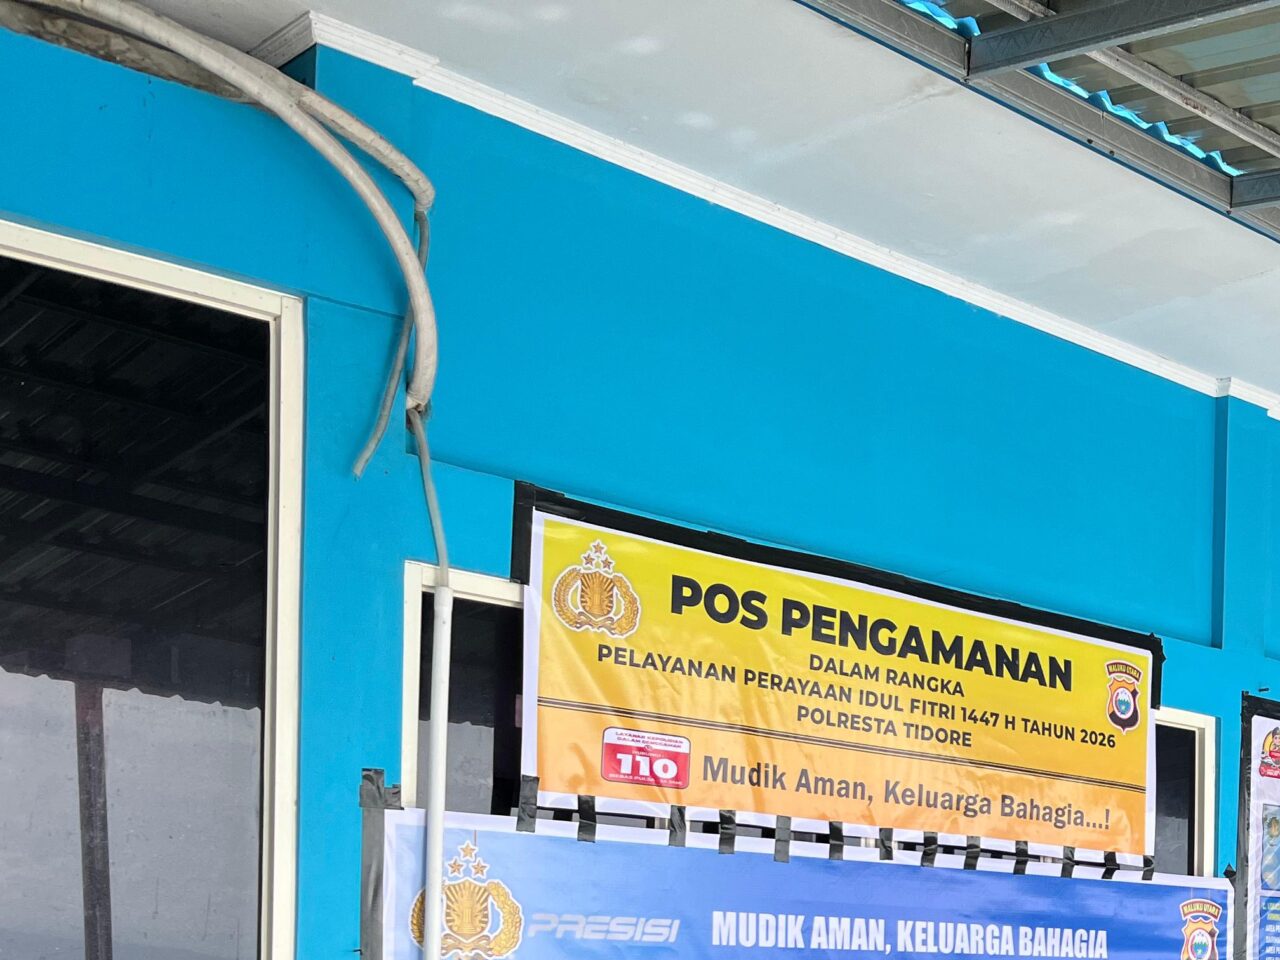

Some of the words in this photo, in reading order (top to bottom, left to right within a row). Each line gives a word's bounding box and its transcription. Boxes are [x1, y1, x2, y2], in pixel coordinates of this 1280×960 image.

[671, 575, 768, 629] POS
[781, 598, 1072, 692] PENGAMANAN
[597, 645, 736, 683] PELAYANAN
[744, 669, 852, 703] PERAYAAN
[859, 690, 904, 712] IDUL
[910, 699, 956, 720] FITRI
[961, 707, 999, 727] 1447
[1004, 716, 1016, 730] H
[1021, 718, 1075, 741] TAHUN
[1080, 729, 1116, 748] 2026
[809, 655, 880, 682] DALAM
[886, 670, 965, 697] RANGKA
[797, 706, 898, 736] POLRESTA
[903, 722, 972, 747] TIDORE
[616, 753, 678, 779] 110
[702, 756, 786, 790] Mudik
[795, 768, 873, 806] Aman,
[884, 780, 991, 817] Keluarga
[527, 913, 681, 943] PRESISI
[711, 911, 804, 948] MUDIK
[810, 916, 892, 955] AMAN,
[897, 919, 1014, 956] KELUARGA
[1018, 925, 1108, 960] BAHAGIA
